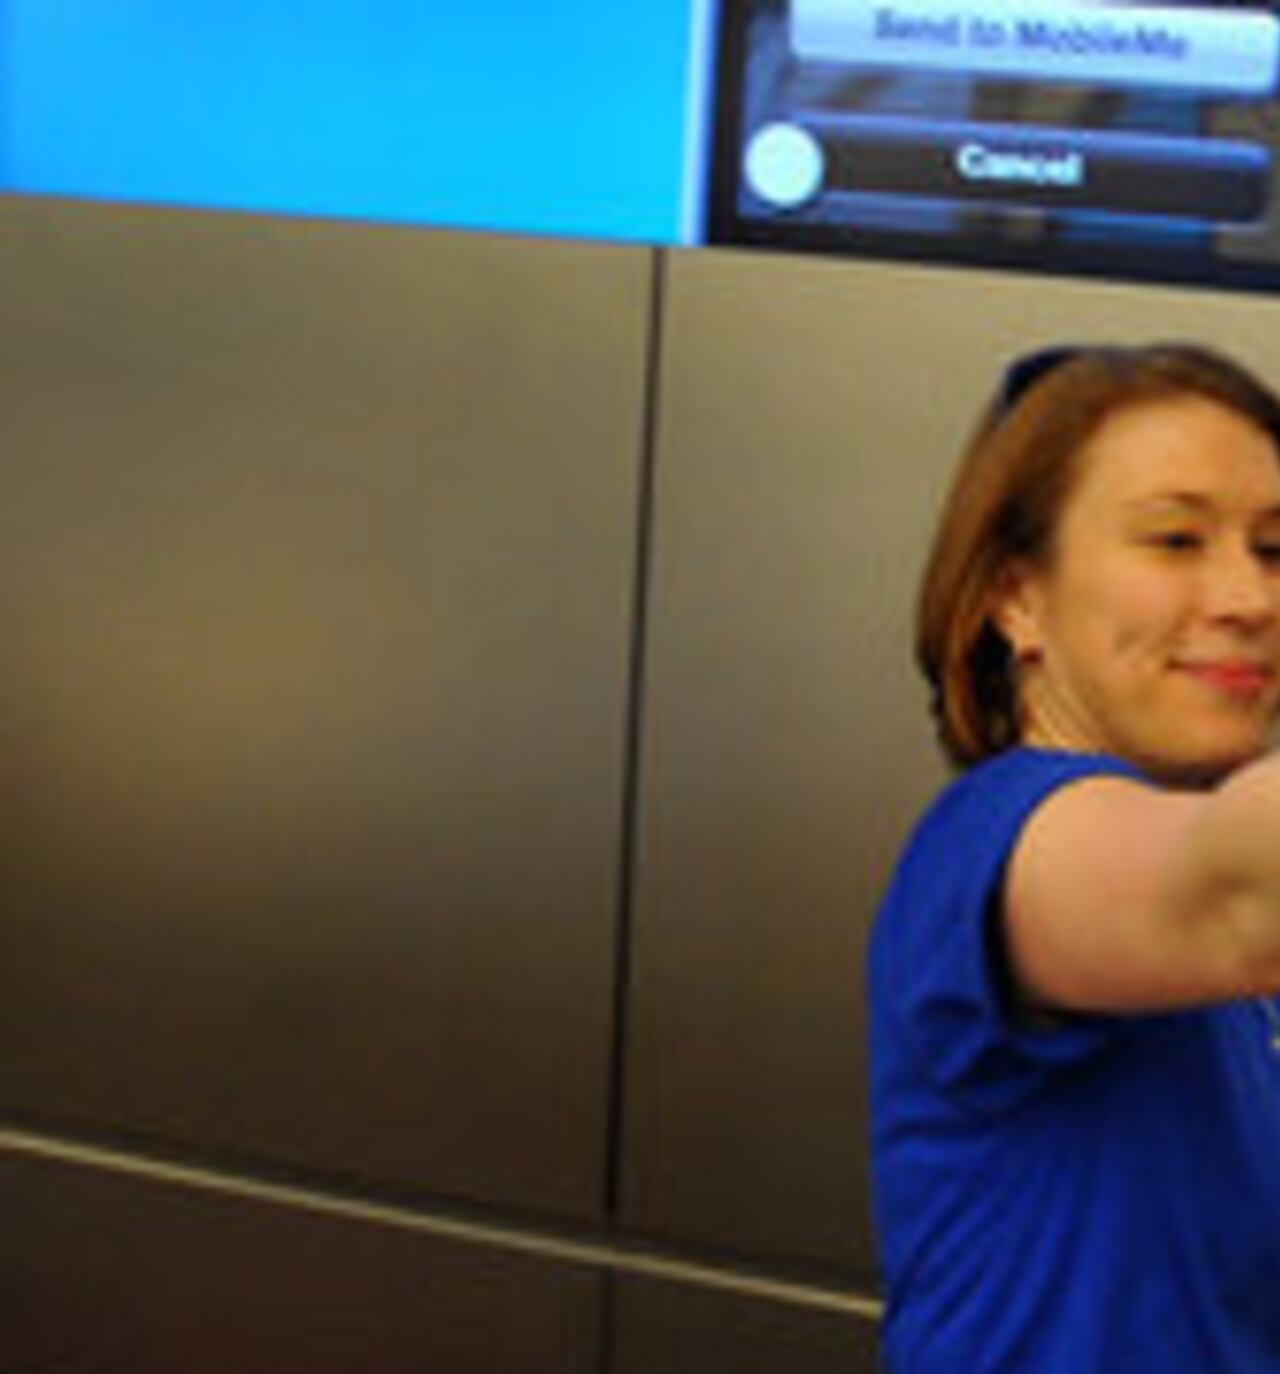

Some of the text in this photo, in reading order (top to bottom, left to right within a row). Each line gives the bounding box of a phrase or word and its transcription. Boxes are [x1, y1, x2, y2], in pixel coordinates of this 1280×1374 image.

[873, 9, 1190, 60] Send to MobileMe
[956, 143, 1085, 187] Cancel
